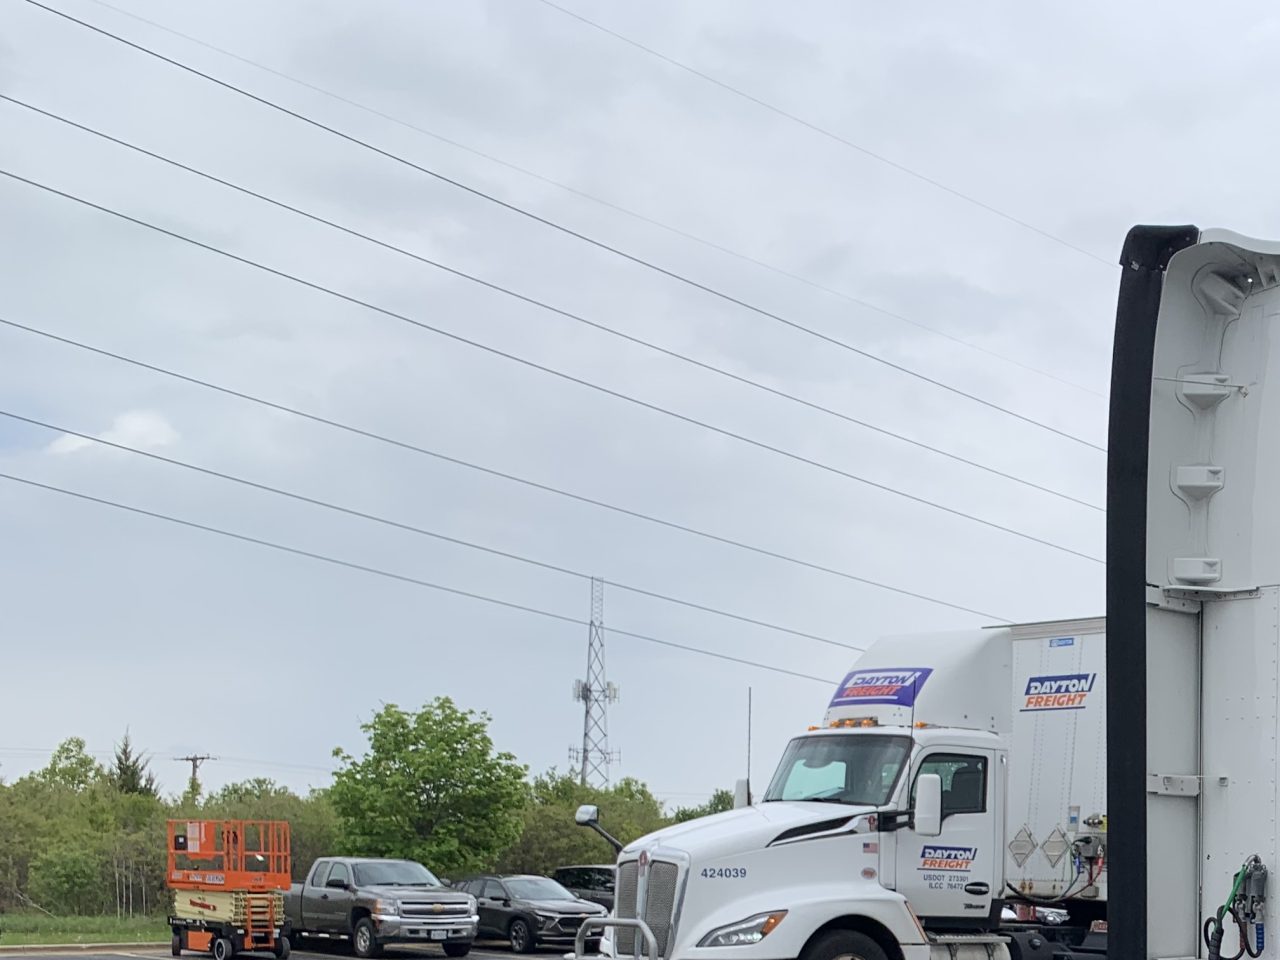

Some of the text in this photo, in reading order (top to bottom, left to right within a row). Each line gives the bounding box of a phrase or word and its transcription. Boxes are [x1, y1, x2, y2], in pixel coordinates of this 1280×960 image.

[852, 673, 910, 686] DAYTON
[843, 685, 901, 697] FREIGHT
[1029, 678, 1091, 694] DAYTON
[1025, 693, 1087, 708] FREIGHT
[924, 848, 974, 860] DAYTON
[922, 859, 971, 869] FREIGHT
[701, 868, 747, 879] 424039
